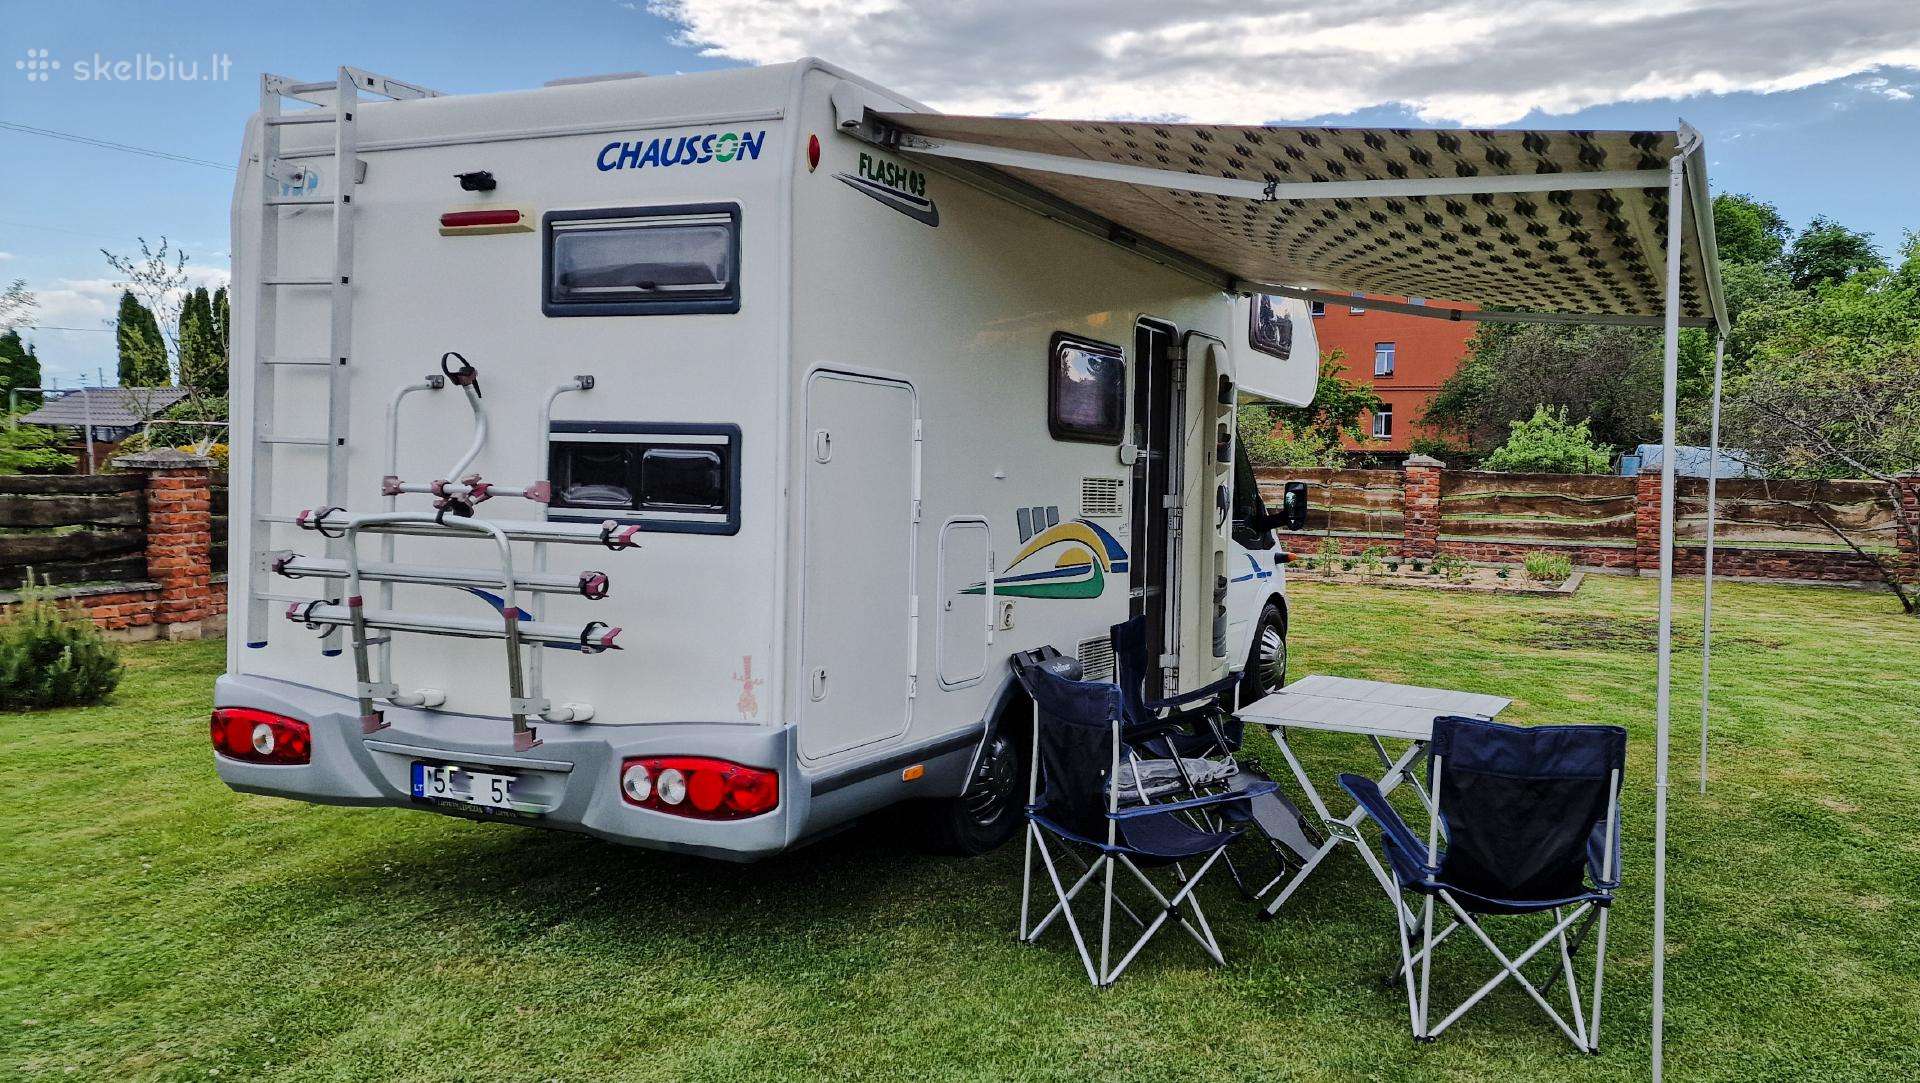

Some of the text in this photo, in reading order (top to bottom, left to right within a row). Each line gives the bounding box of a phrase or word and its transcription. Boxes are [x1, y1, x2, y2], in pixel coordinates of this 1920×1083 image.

[596, 130, 766, 172] CHAUSSON
[858, 152, 926, 197] FLASH 03
[413, 784, 424, 792] LT
